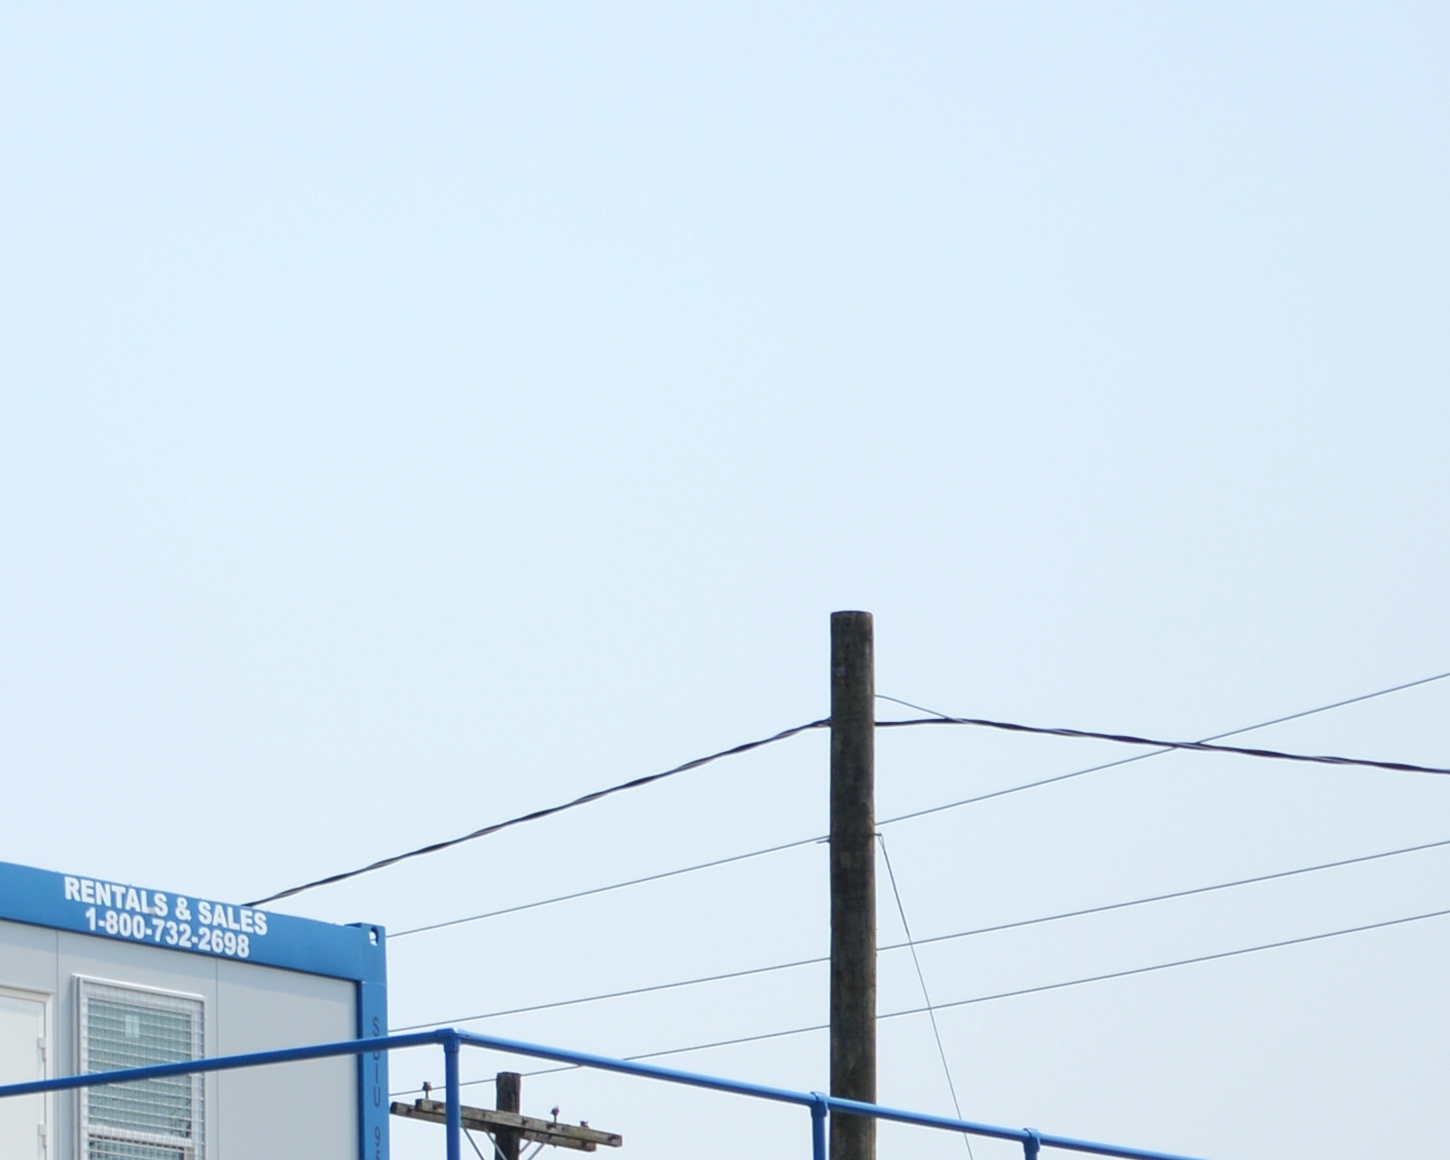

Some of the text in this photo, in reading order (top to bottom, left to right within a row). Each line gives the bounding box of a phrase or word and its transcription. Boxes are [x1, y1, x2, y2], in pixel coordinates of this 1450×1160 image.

[64, 876, 268, 936] RENTALS & SALES
[85, 907, 250, 958] 1-800-732-2698
